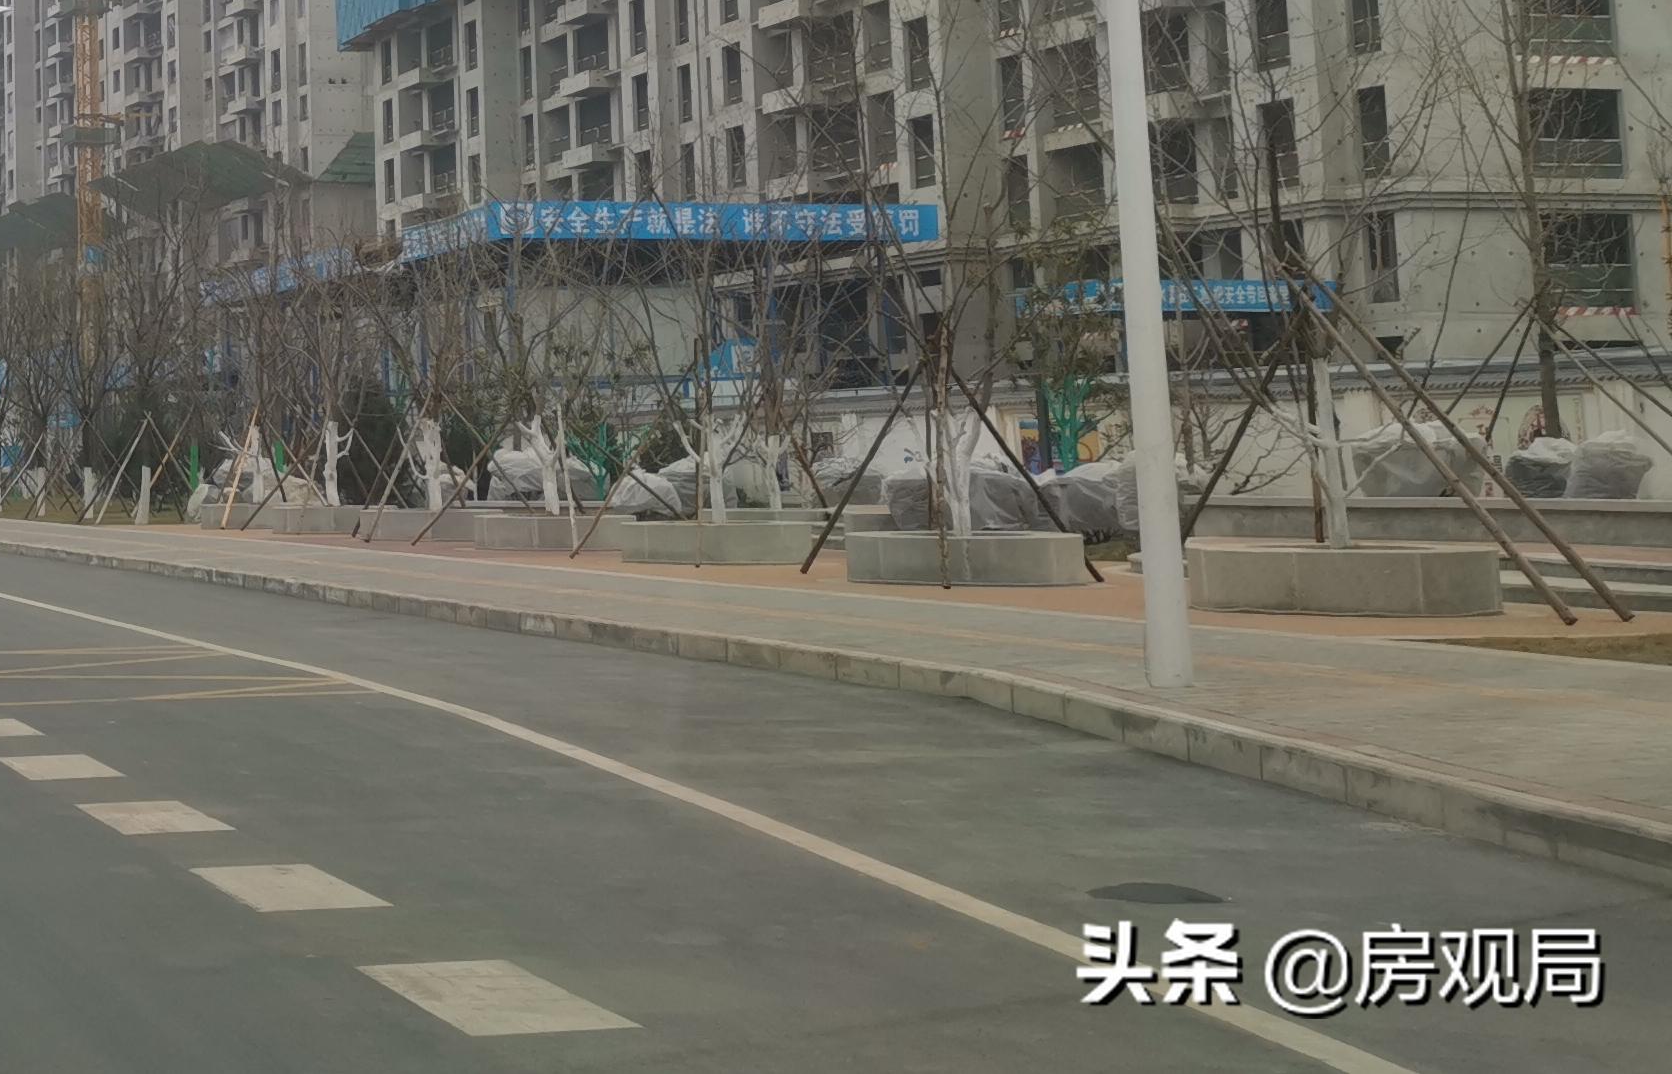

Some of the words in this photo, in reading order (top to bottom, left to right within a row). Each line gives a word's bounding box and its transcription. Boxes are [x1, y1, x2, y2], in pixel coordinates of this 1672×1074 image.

[540, 206, 722, 235] 安全生产就是法
